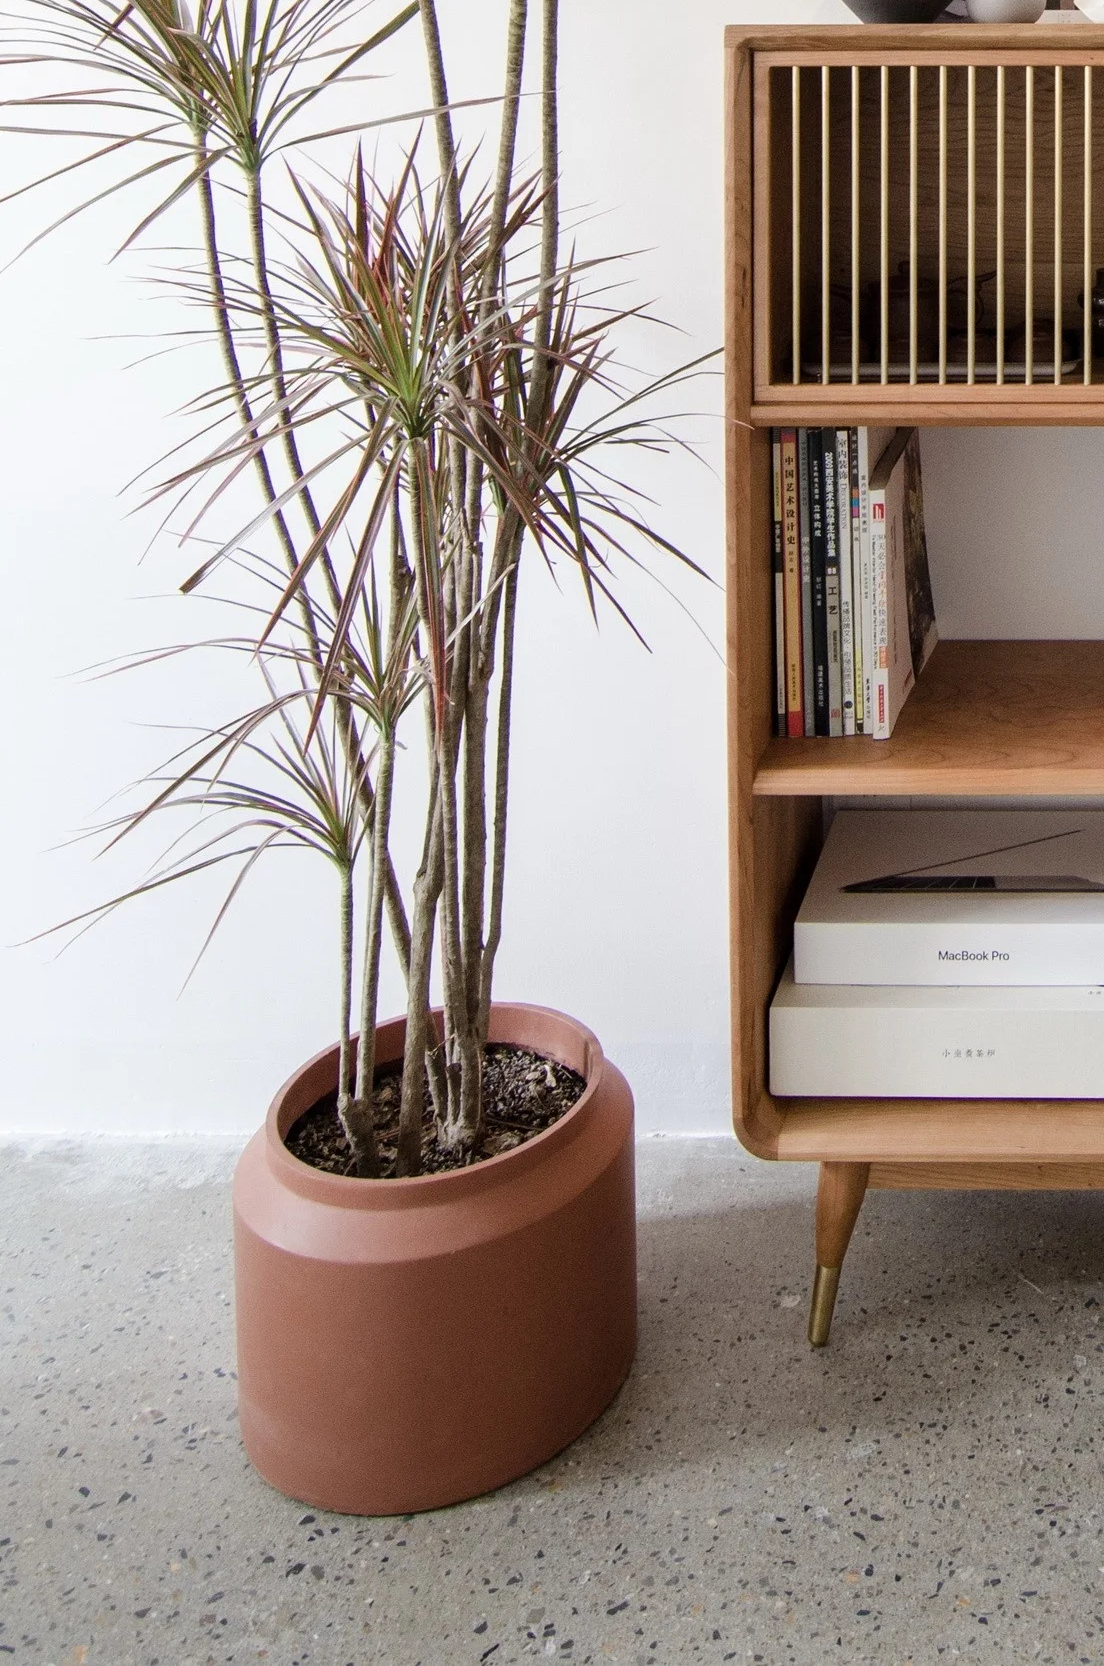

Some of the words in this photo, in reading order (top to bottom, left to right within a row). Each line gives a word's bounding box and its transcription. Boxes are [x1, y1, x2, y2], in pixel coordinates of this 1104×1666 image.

[836, 438, 848, 480] 室内装饰
[784, 456, 797, 545] 中国艺术设计史
[812, 505, 822, 537] 立体构成
[828, 586, 839, 615] 工艺
[938, 950, 989, 961] MacBook
[992, 950, 1010, 961] Pro
